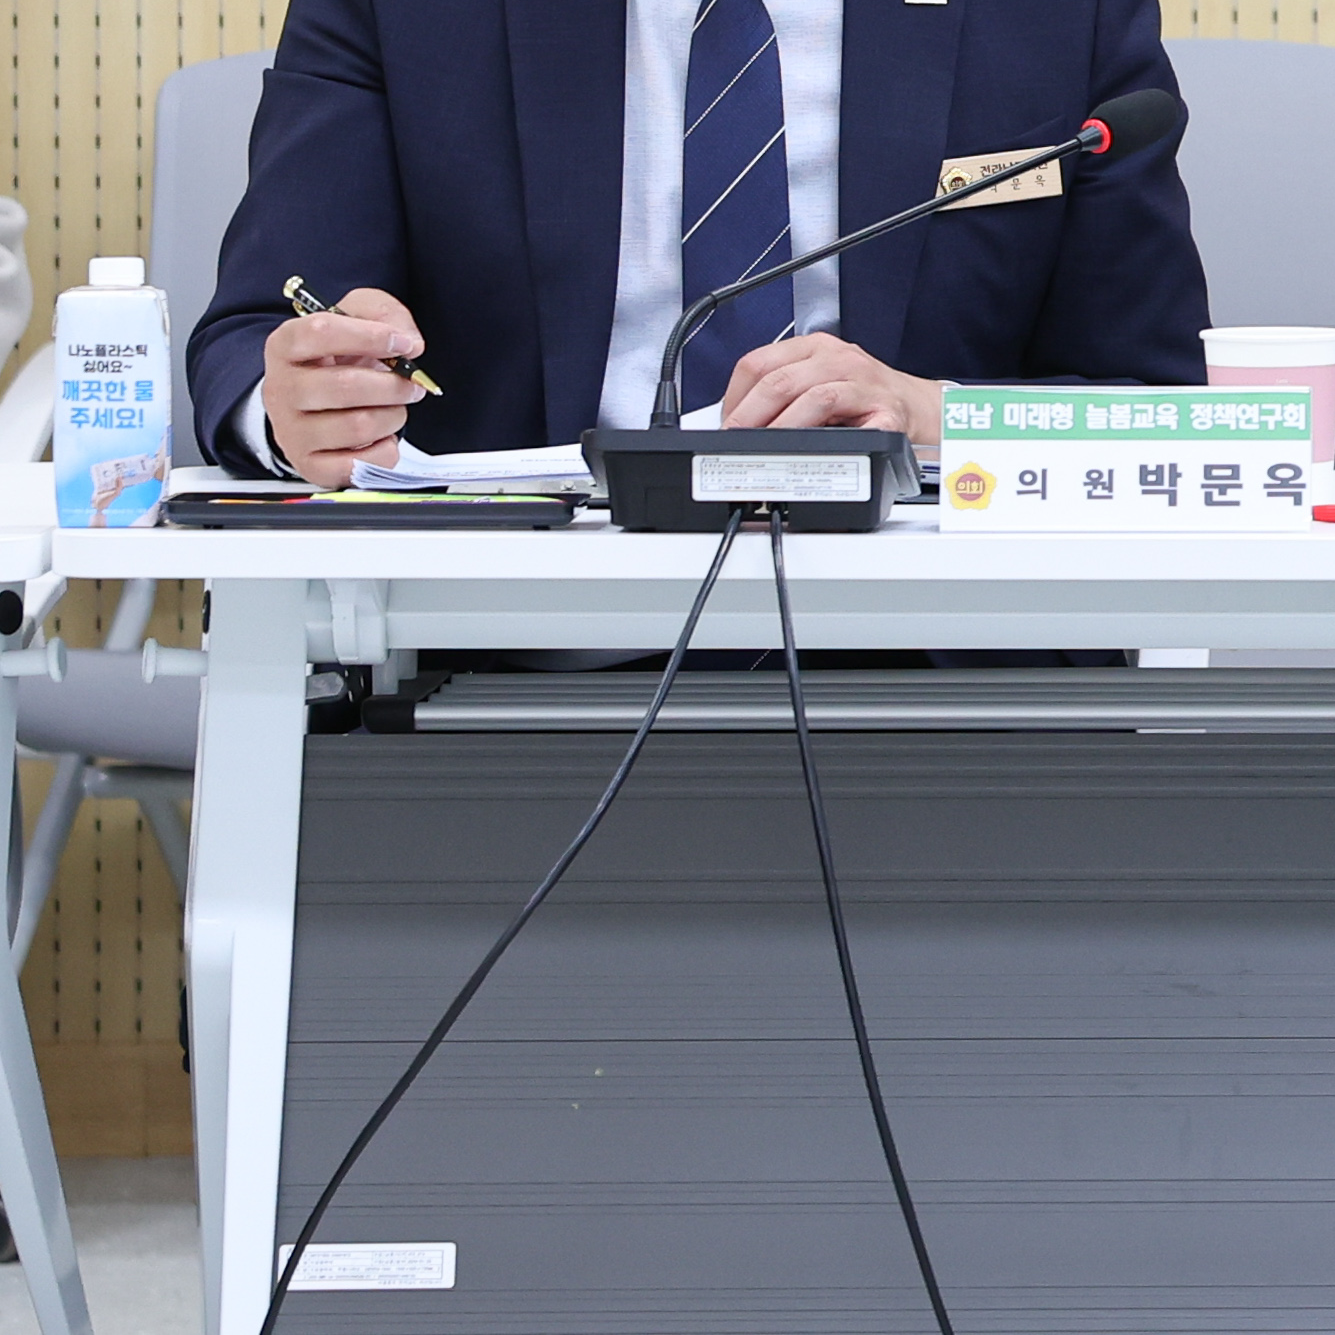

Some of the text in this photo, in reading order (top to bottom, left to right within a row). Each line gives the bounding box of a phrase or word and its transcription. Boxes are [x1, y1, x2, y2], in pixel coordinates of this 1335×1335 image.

[68, 344, 148, 357] 나노플라스틱
[62, 380, 154, 402] 깨끗한 물
[70, 407, 145, 429] 주세요!
[944, 402, 1307, 431] 전남 미래형 늘봄교육 정책연구회
[956, 481, 984, 495] 의회
